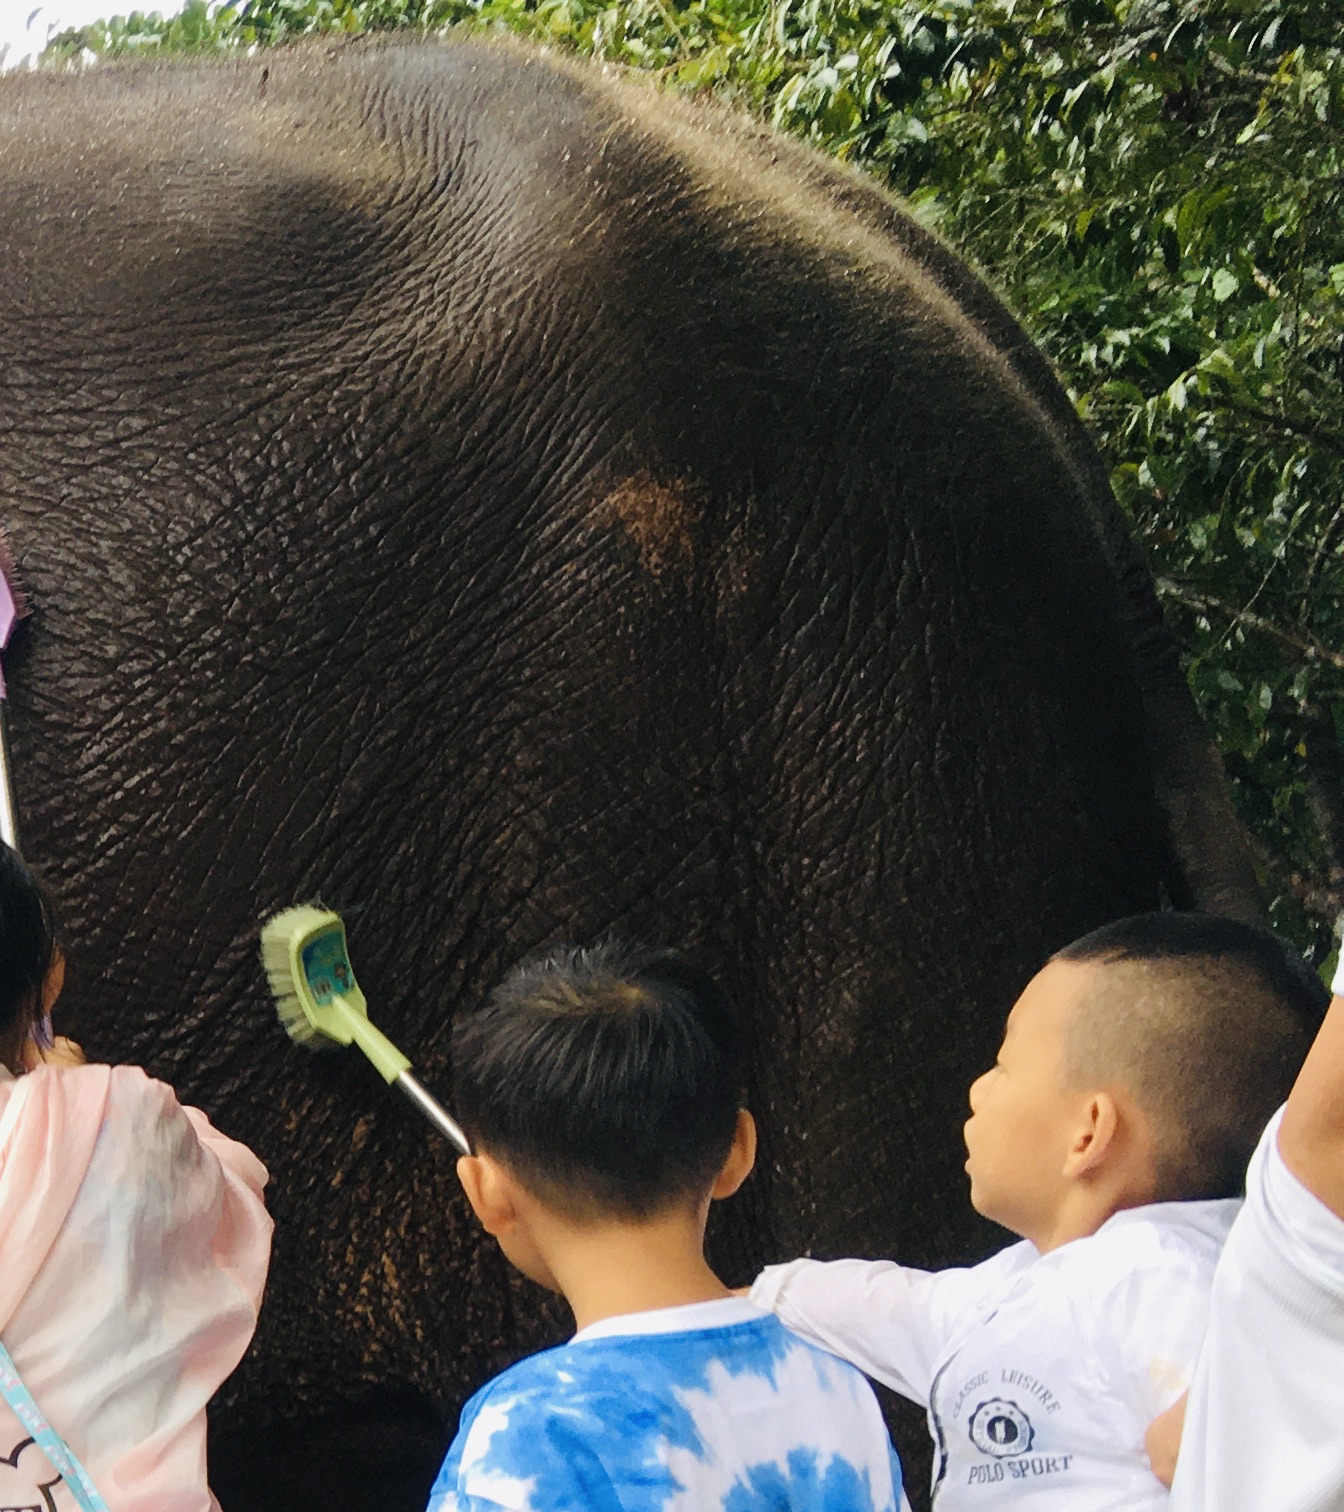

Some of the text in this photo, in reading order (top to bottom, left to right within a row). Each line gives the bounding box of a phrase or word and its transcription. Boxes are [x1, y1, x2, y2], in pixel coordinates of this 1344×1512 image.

[1000, 1368, 1062, 1415] LEISURE
[967, 1455, 1074, 1485] POLO SPORT
